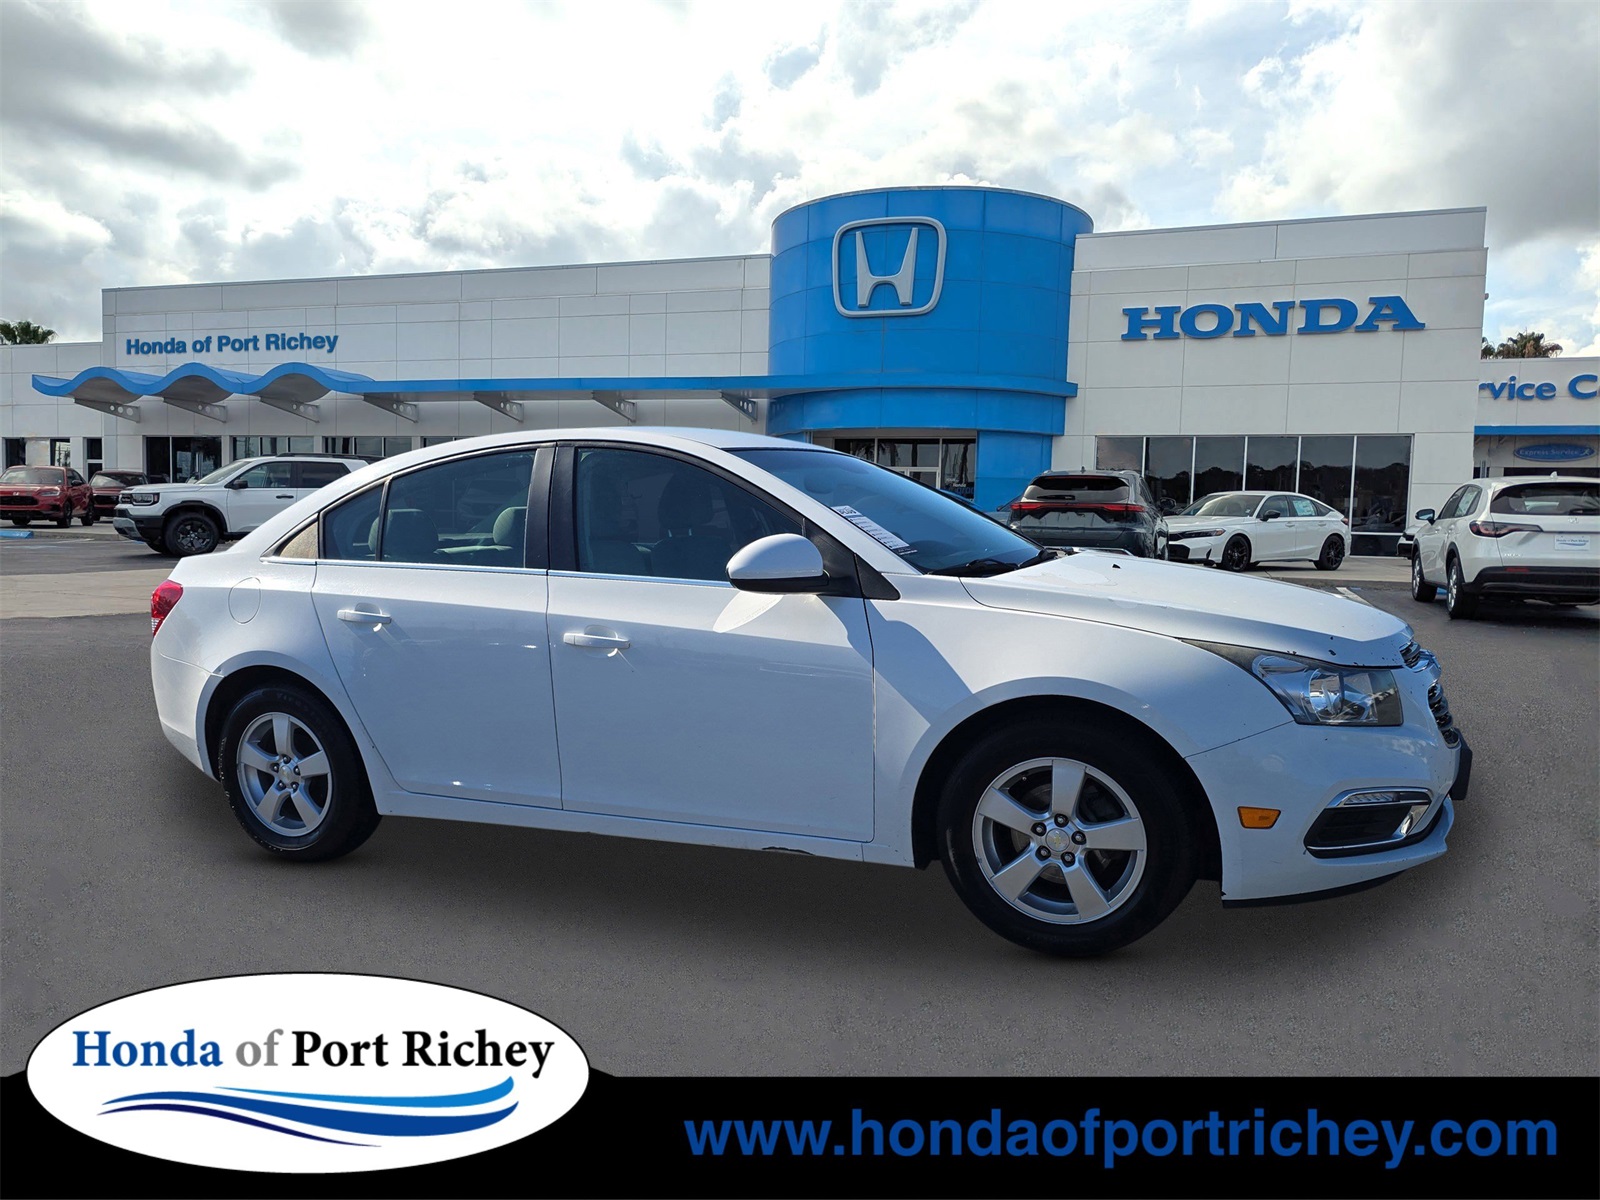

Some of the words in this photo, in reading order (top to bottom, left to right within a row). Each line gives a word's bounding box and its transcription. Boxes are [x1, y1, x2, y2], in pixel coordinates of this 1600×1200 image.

[1121, 295, 1426, 341] HONDA
[126, 337, 187, 355] Honda
[192, 336, 212, 353] of
[217, 335, 260, 352] Port
[265, 332, 339, 353] Richey
[1568, 374, 1600, 400] C
